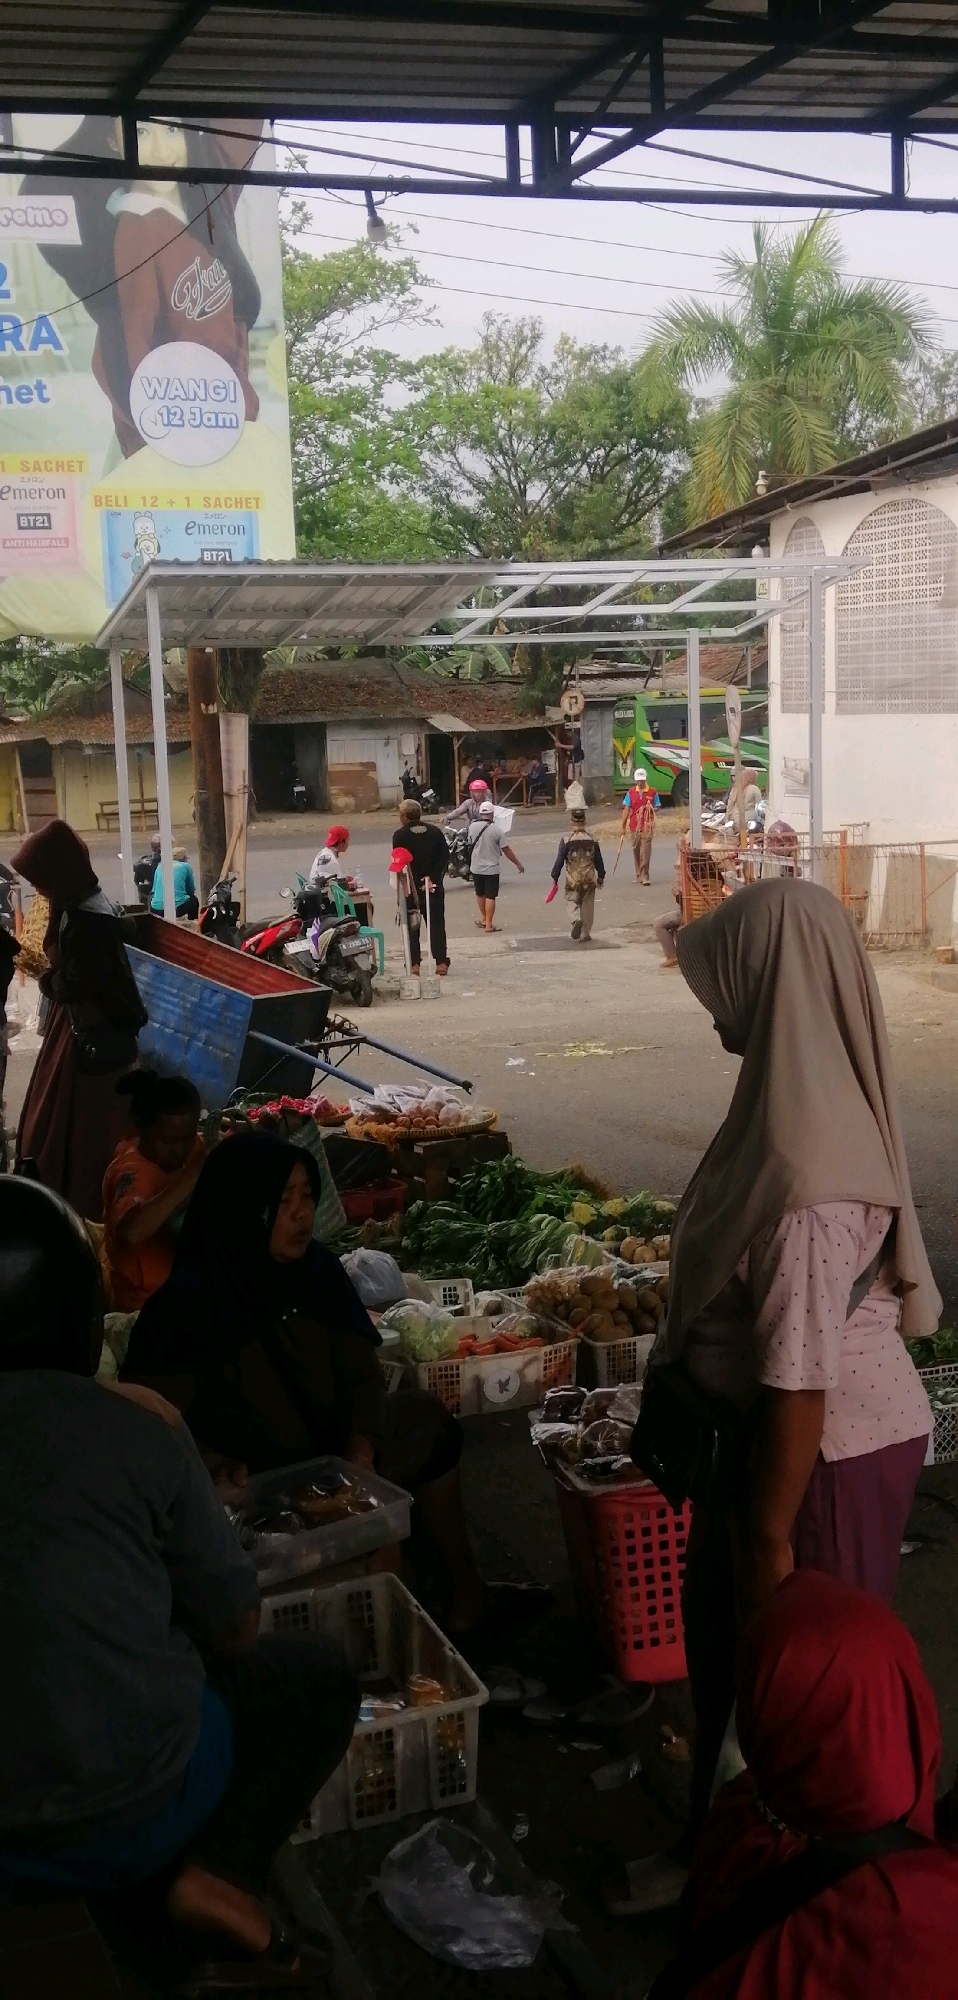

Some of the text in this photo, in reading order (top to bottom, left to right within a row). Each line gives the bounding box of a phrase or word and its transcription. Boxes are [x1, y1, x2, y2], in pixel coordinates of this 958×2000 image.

[0, 314, 64, 352] RA
[140, 376, 237, 403] WANGI
[157, 405, 239, 429] 12 Jam
[20, 460, 85, 473] SACHET
[0, 485, 66, 501] emeron
[93, 494, 261, 509] BELI 12 + 1 SACHET
[19, 515, 50, 527] BT21
[185, 520, 246, 536] emeron
[5, 539, 67, 547] ANTI HAIRFALL
